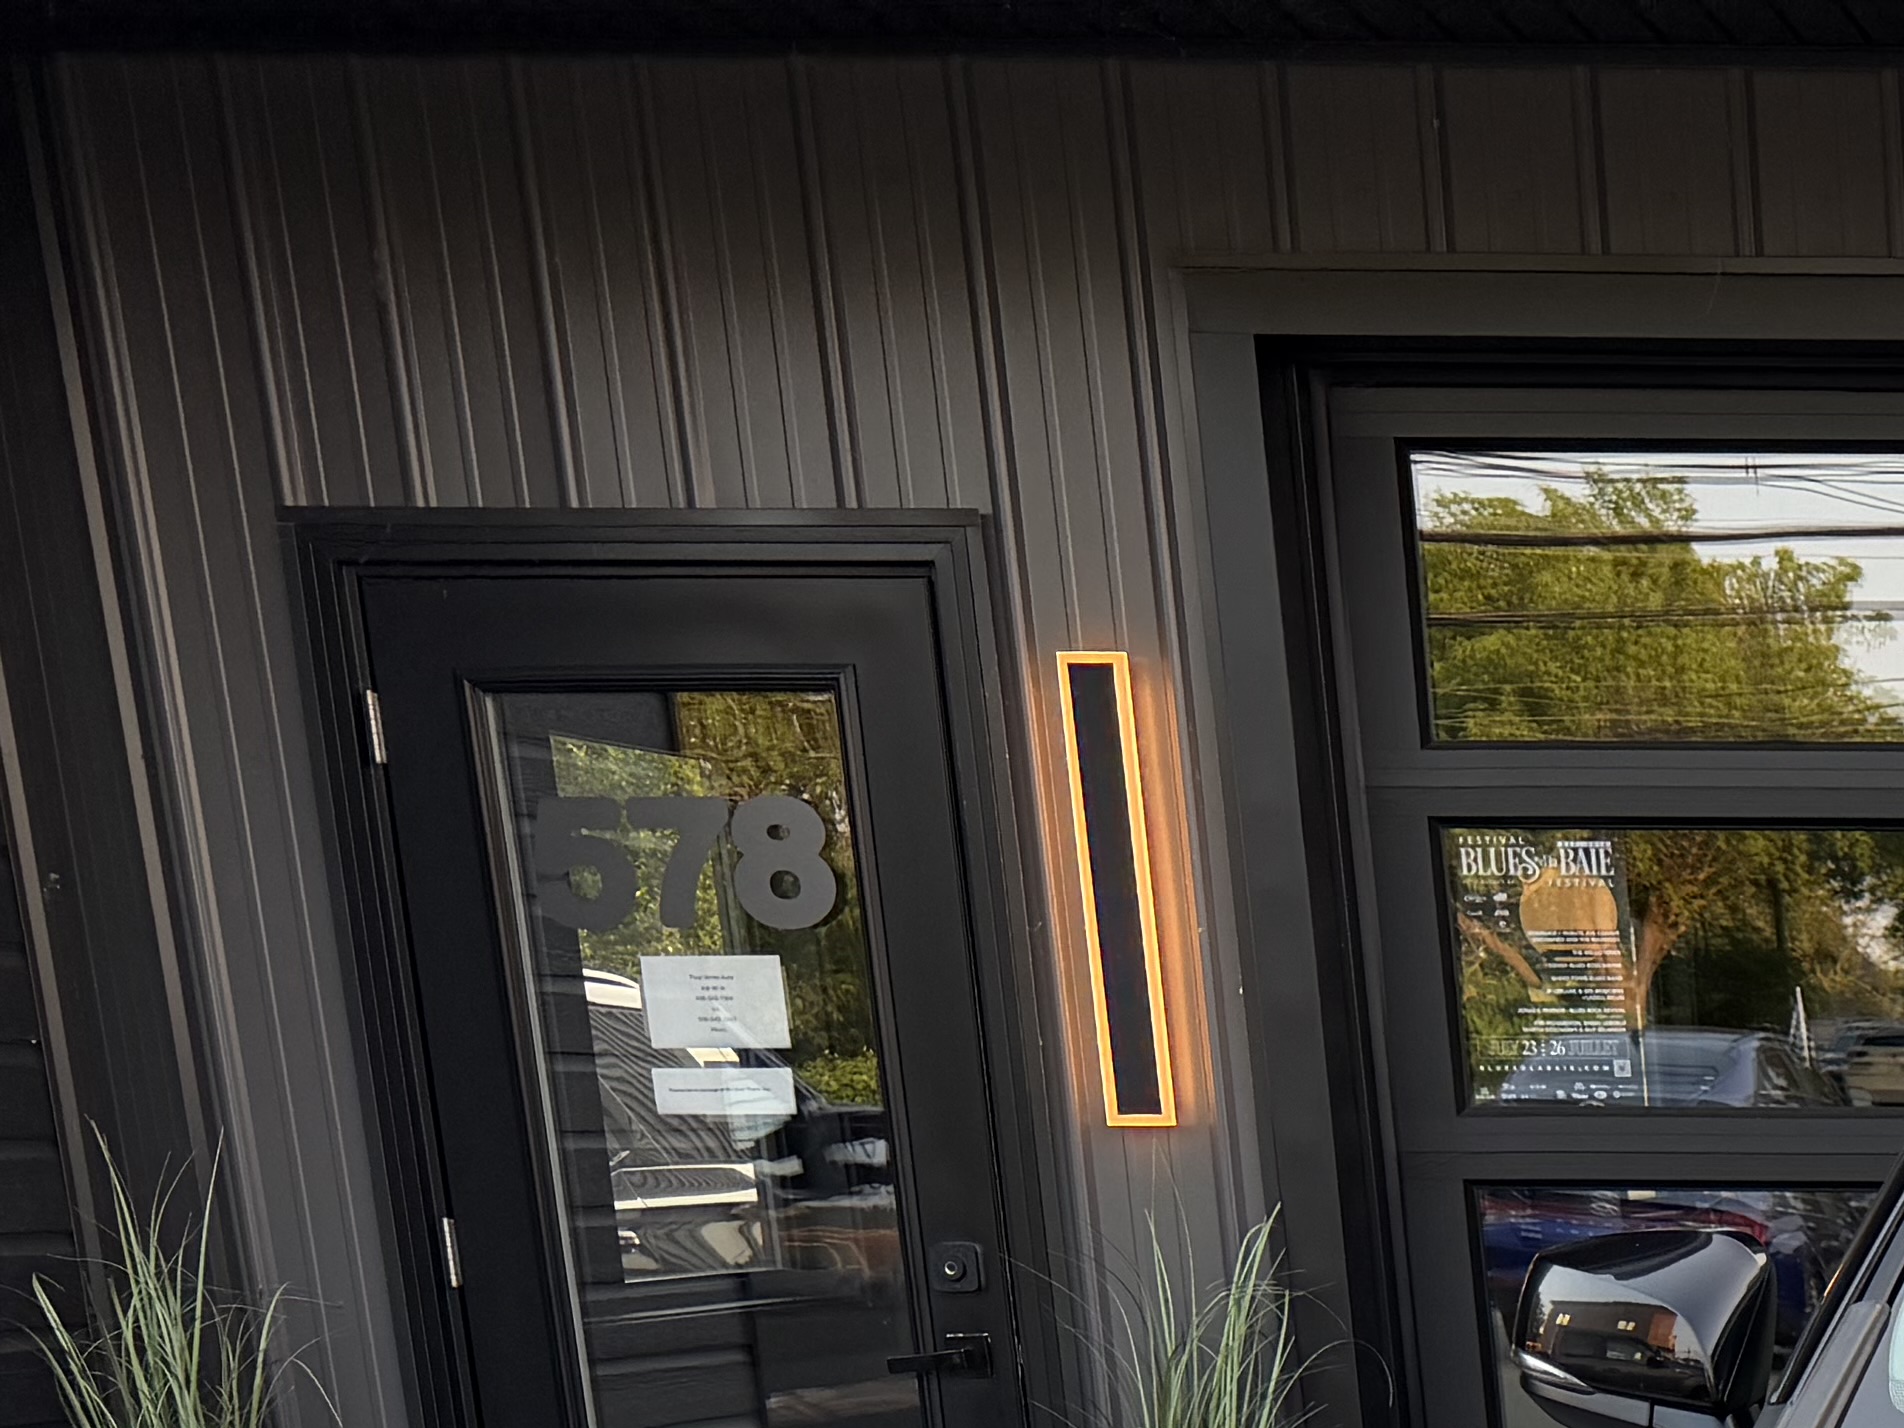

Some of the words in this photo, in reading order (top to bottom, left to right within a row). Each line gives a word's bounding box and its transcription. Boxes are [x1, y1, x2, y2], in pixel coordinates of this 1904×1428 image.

[1458, 836, 1525, 845] FESTIVAL
[534, 796, 838, 930] 578
[1459, 847, 1541, 884] BLUES
[1558, 848, 1615, 876] BAIE
[1548, 877, 1615, 888] FESTIVAL
[1522, 1040, 1538, 1055] 23
[1550, 1040, 1566, 1056] 26
[1567, 1040, 1619, 1056] JUILLET
